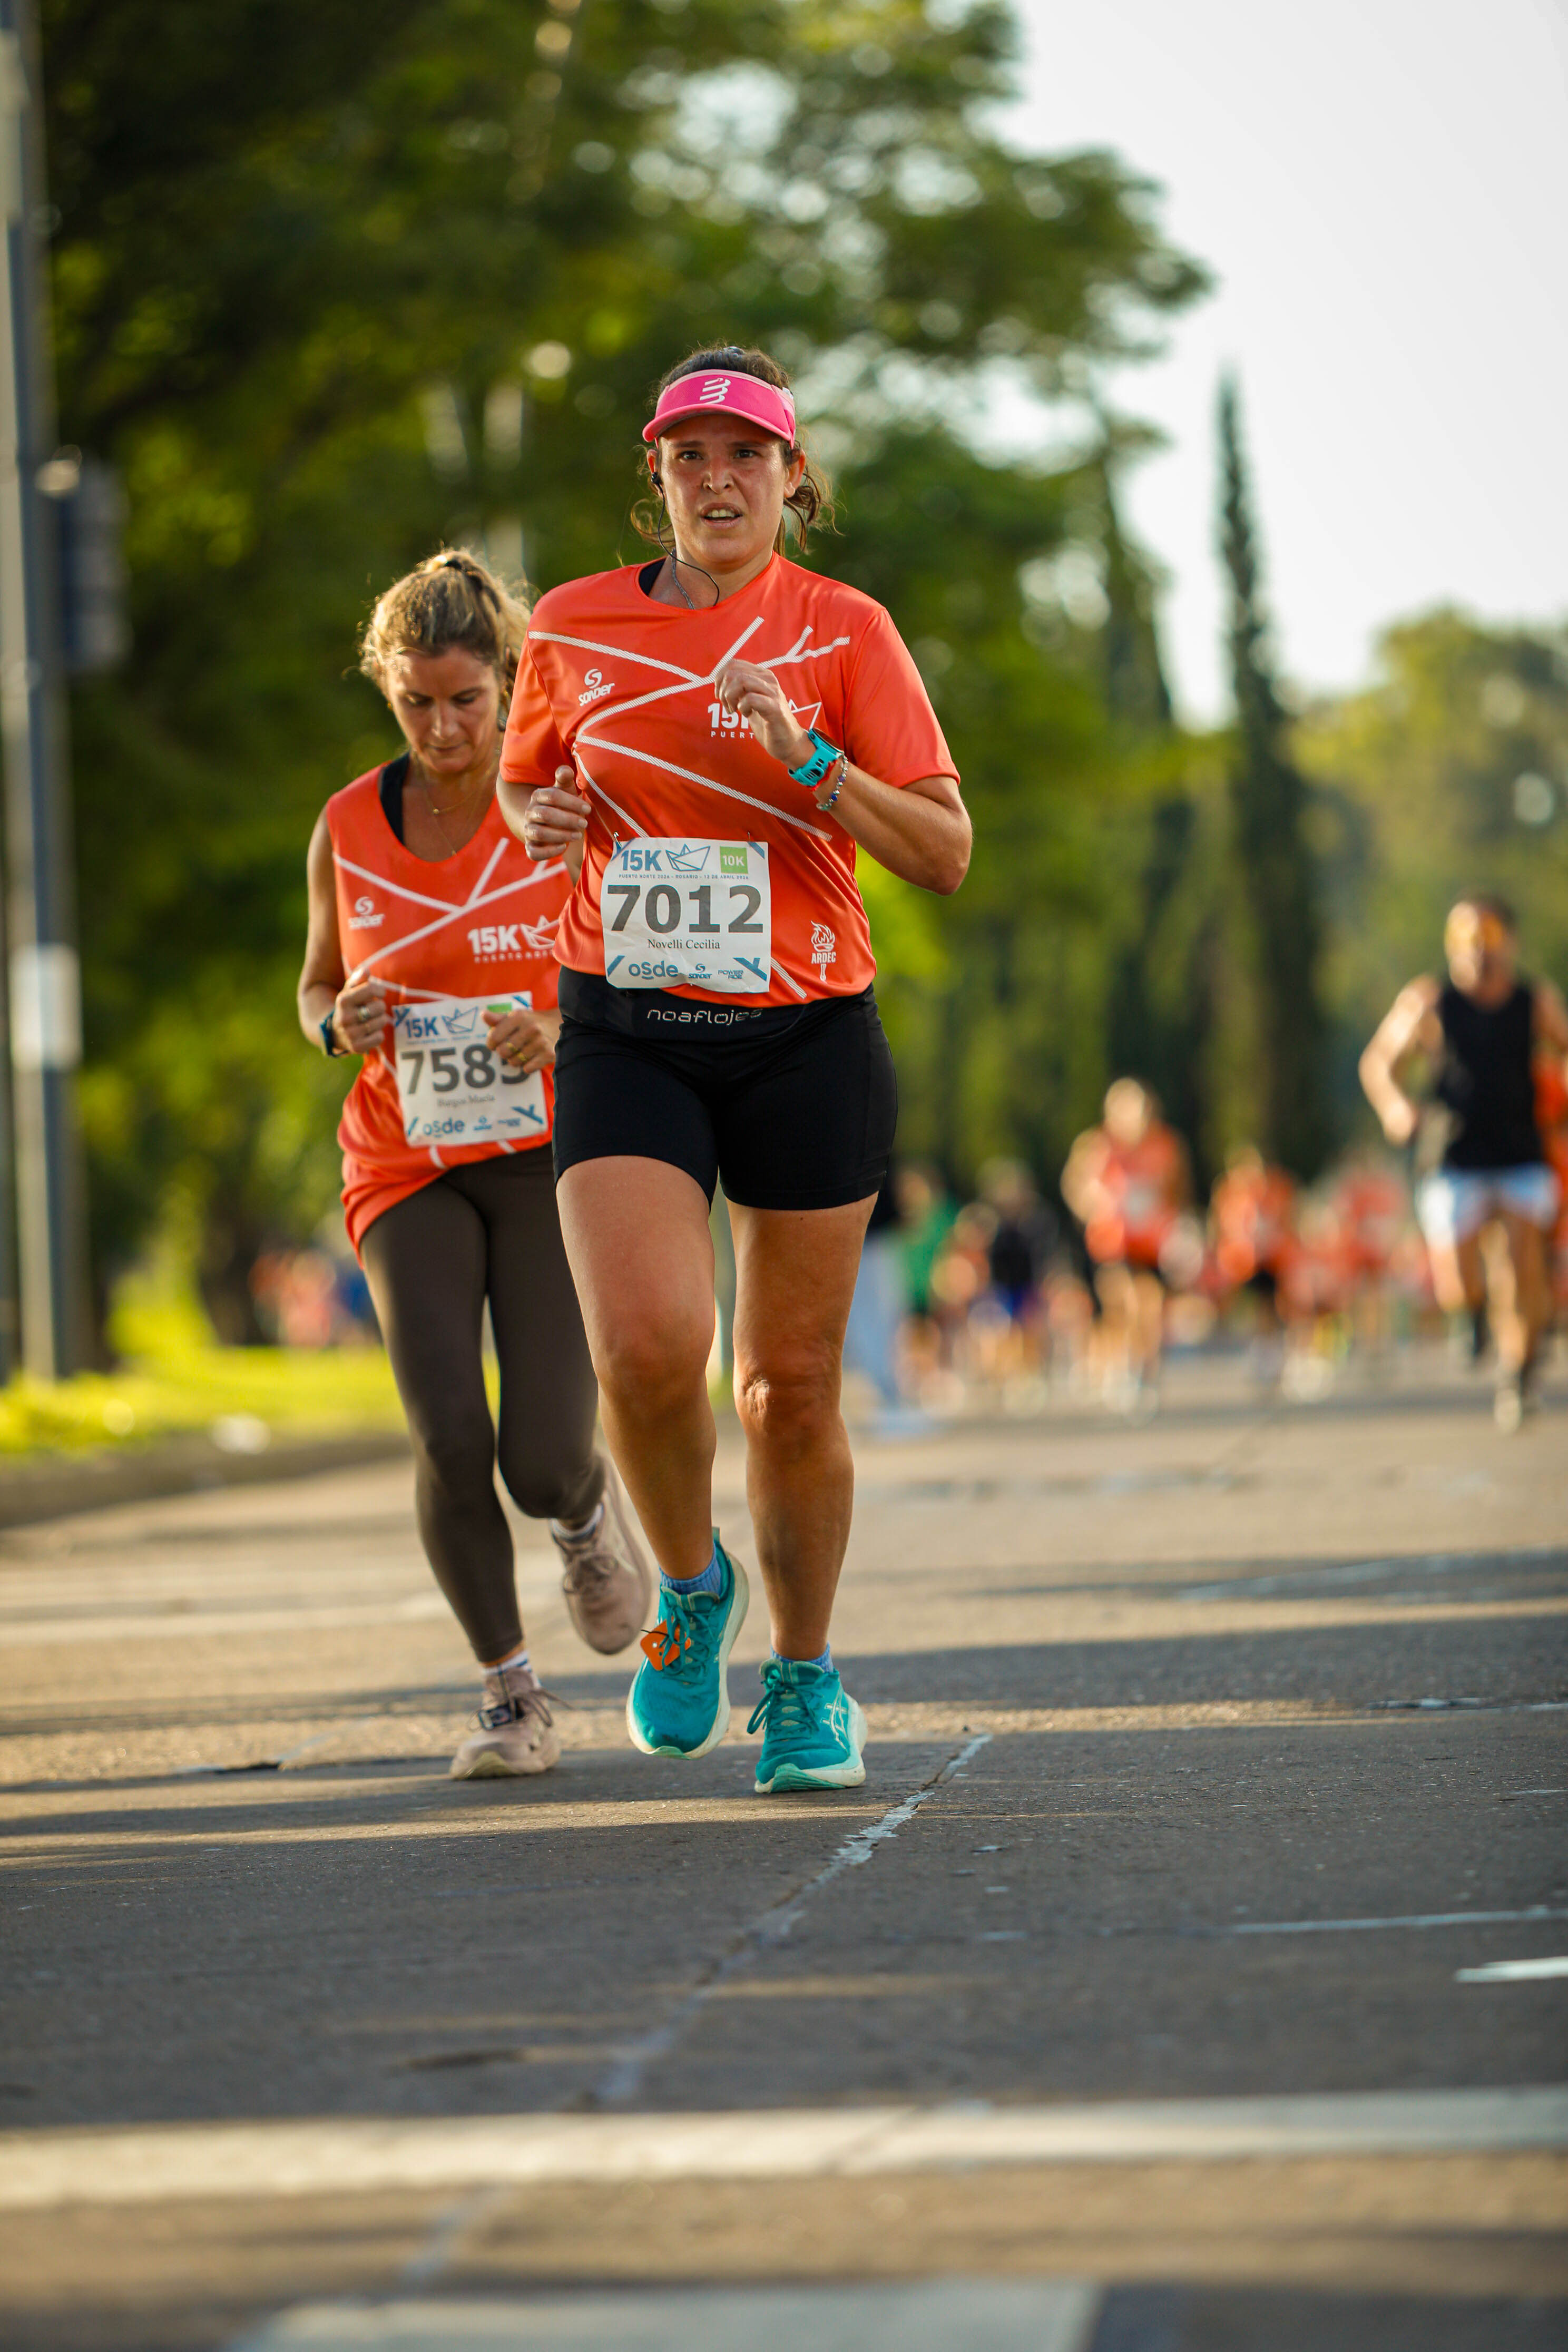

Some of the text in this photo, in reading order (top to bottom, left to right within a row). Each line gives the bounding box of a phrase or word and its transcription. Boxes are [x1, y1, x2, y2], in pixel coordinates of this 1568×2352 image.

[621, 849, 662, 871] 15K
[722, 854, 744, 867] 10K
[607, 885, 763, 933] 7012
[468, 924, 522, 955] 15K
[648, 939, 720, 949] Novelli Cecilia
[811, 952, 837, 964] ARDEC
[628, 961, 679, 978] osde
[647, 1008, 763, 1026] noaflojes
[406, 1016, 439, 1038] 15K
